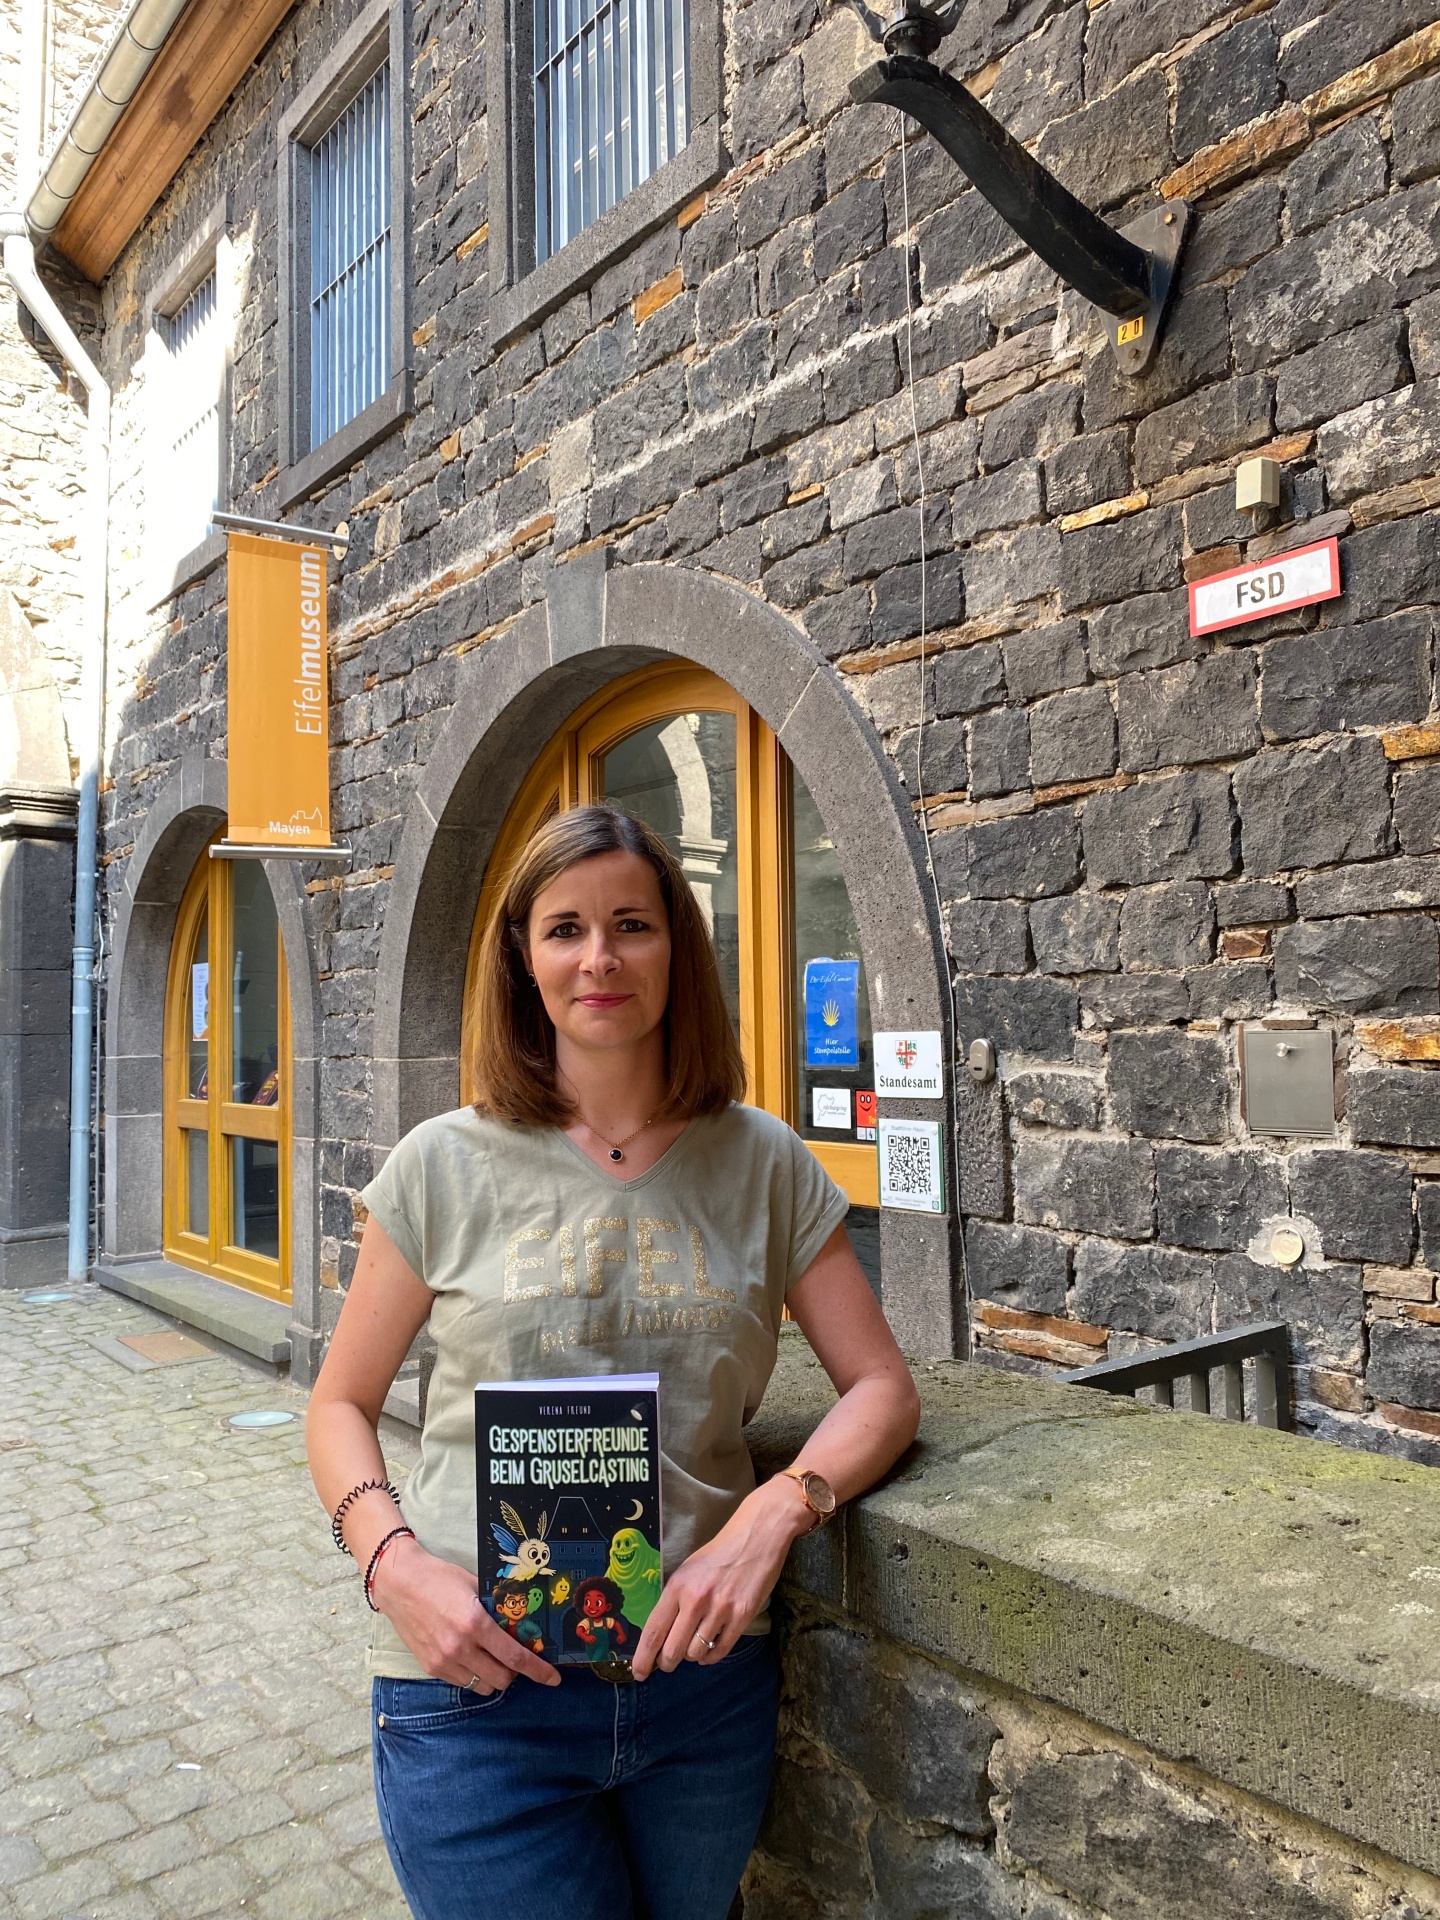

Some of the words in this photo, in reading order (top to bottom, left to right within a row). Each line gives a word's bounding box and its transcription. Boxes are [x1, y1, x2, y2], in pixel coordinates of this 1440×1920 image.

[1236, 571, 1285, 608] FSD
[294, 551, 322, 736] Eifelmuseum
[269, 820, 311, 836] Mayen
[814, 1046, 852, 1056] Stempelstelle
[825, 1038, 839, 1046] Hier
[880, 1075, 937, 1089] Standesamt
[503, 1217, 736, 1305] EIFEL
[538, 1405, 563, 1416] VERENA
[567, 1405, 592, 1415] FREUND
[488, 1425, 649, 1458] GESPENSTERFREUNDE
[489, 1459, 525, 1485] BEIM
[530, 1456, 649, 1490] GRUSELCASTING
